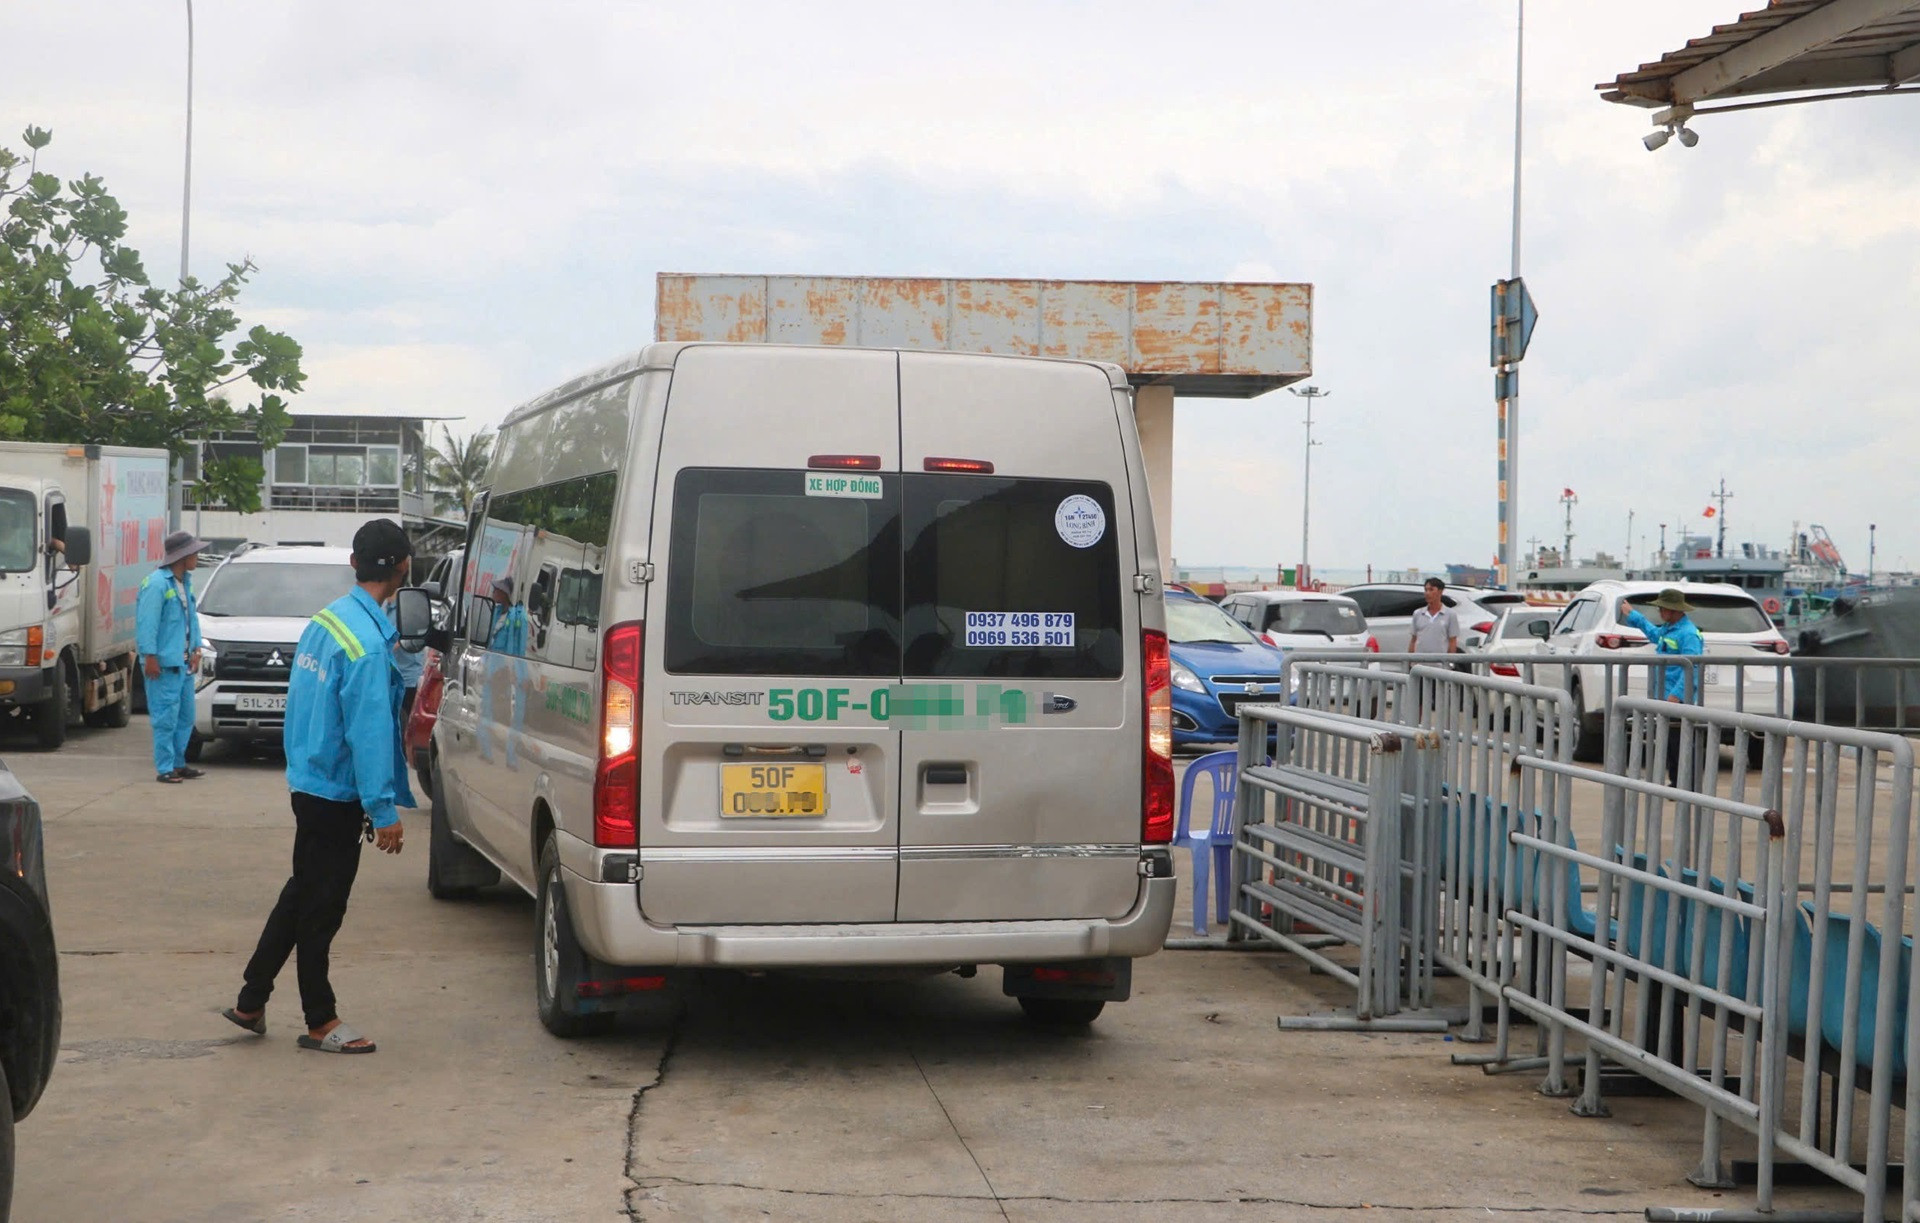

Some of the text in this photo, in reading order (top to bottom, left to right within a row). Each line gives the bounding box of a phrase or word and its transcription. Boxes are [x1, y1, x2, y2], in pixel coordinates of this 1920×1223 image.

[809, 478, 823, 491] XE
[826, 478, 847, 495] HỢP
[967, 612, 1073, 628] 0937 496 879
[967, 630, 1071, 646] 0969 536 501
[669, 690, 765, 706] TRANSIT
[751, 766, 796, 789] 50F
